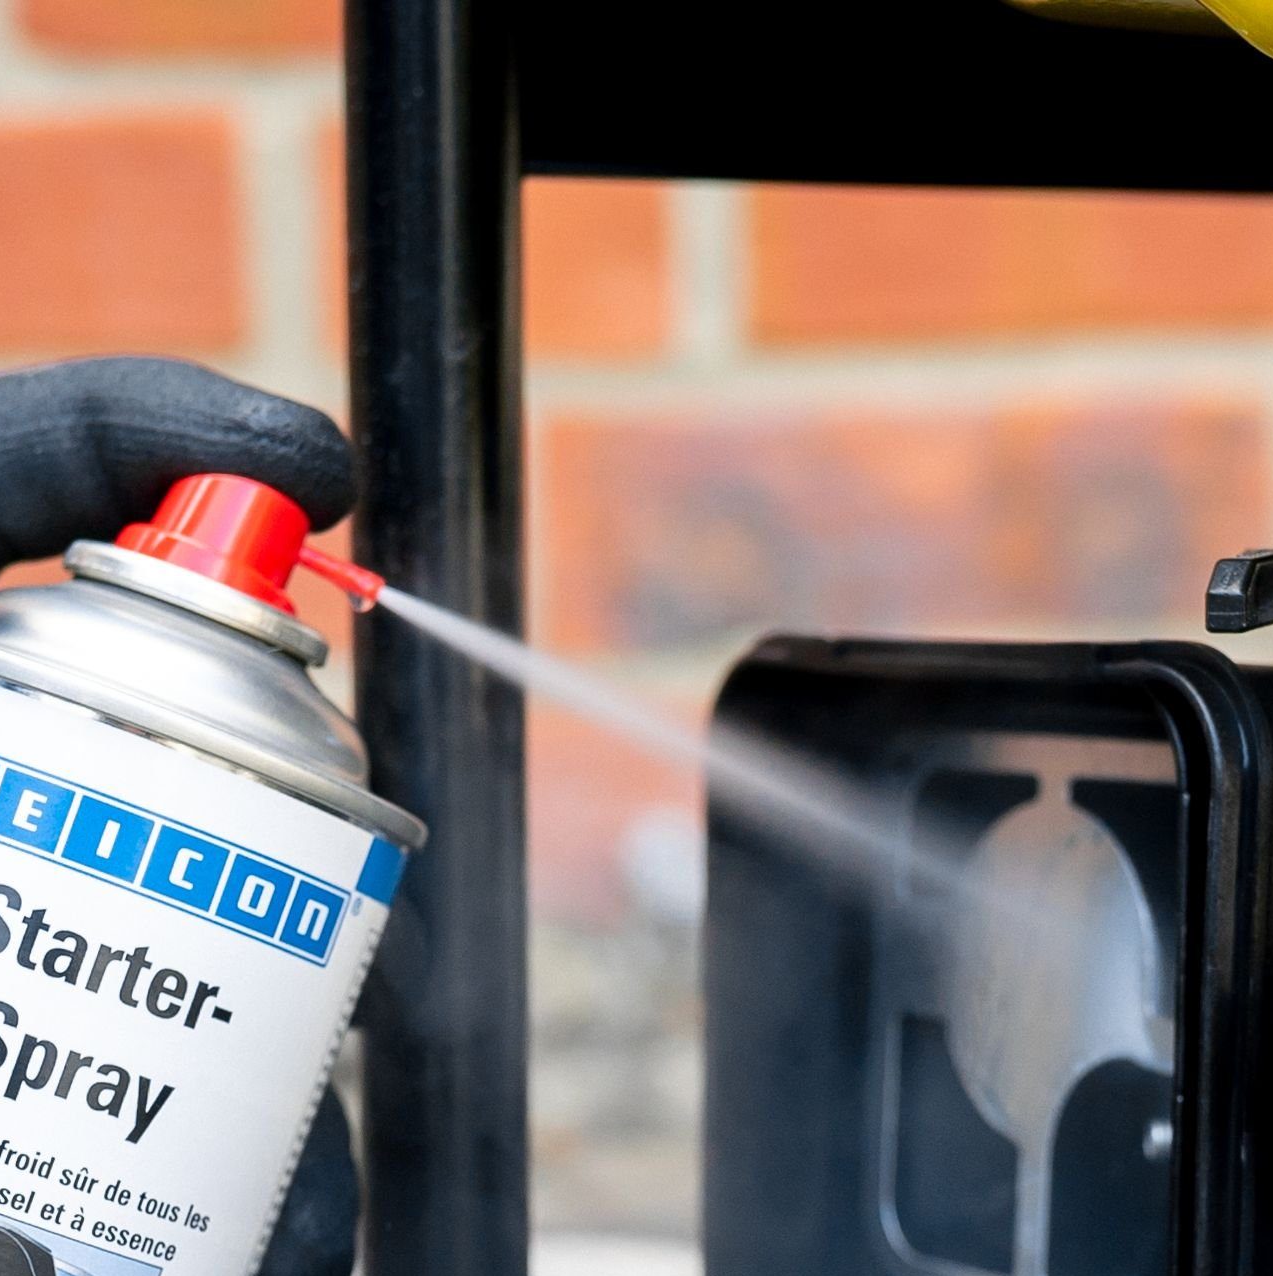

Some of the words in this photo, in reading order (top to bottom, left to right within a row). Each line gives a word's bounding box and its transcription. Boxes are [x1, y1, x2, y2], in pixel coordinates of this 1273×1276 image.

[59, 1164, 99, 1194] sûr
[103, 1181, 132, 1206] de
[136, 1191, 181, 1223] tous
[184, 1204, 211, 1233] les
[39, 1202, 66, 1223] et
[69, 1202, 85, 1232] à
[91, 1218, 178, 1262] essence
